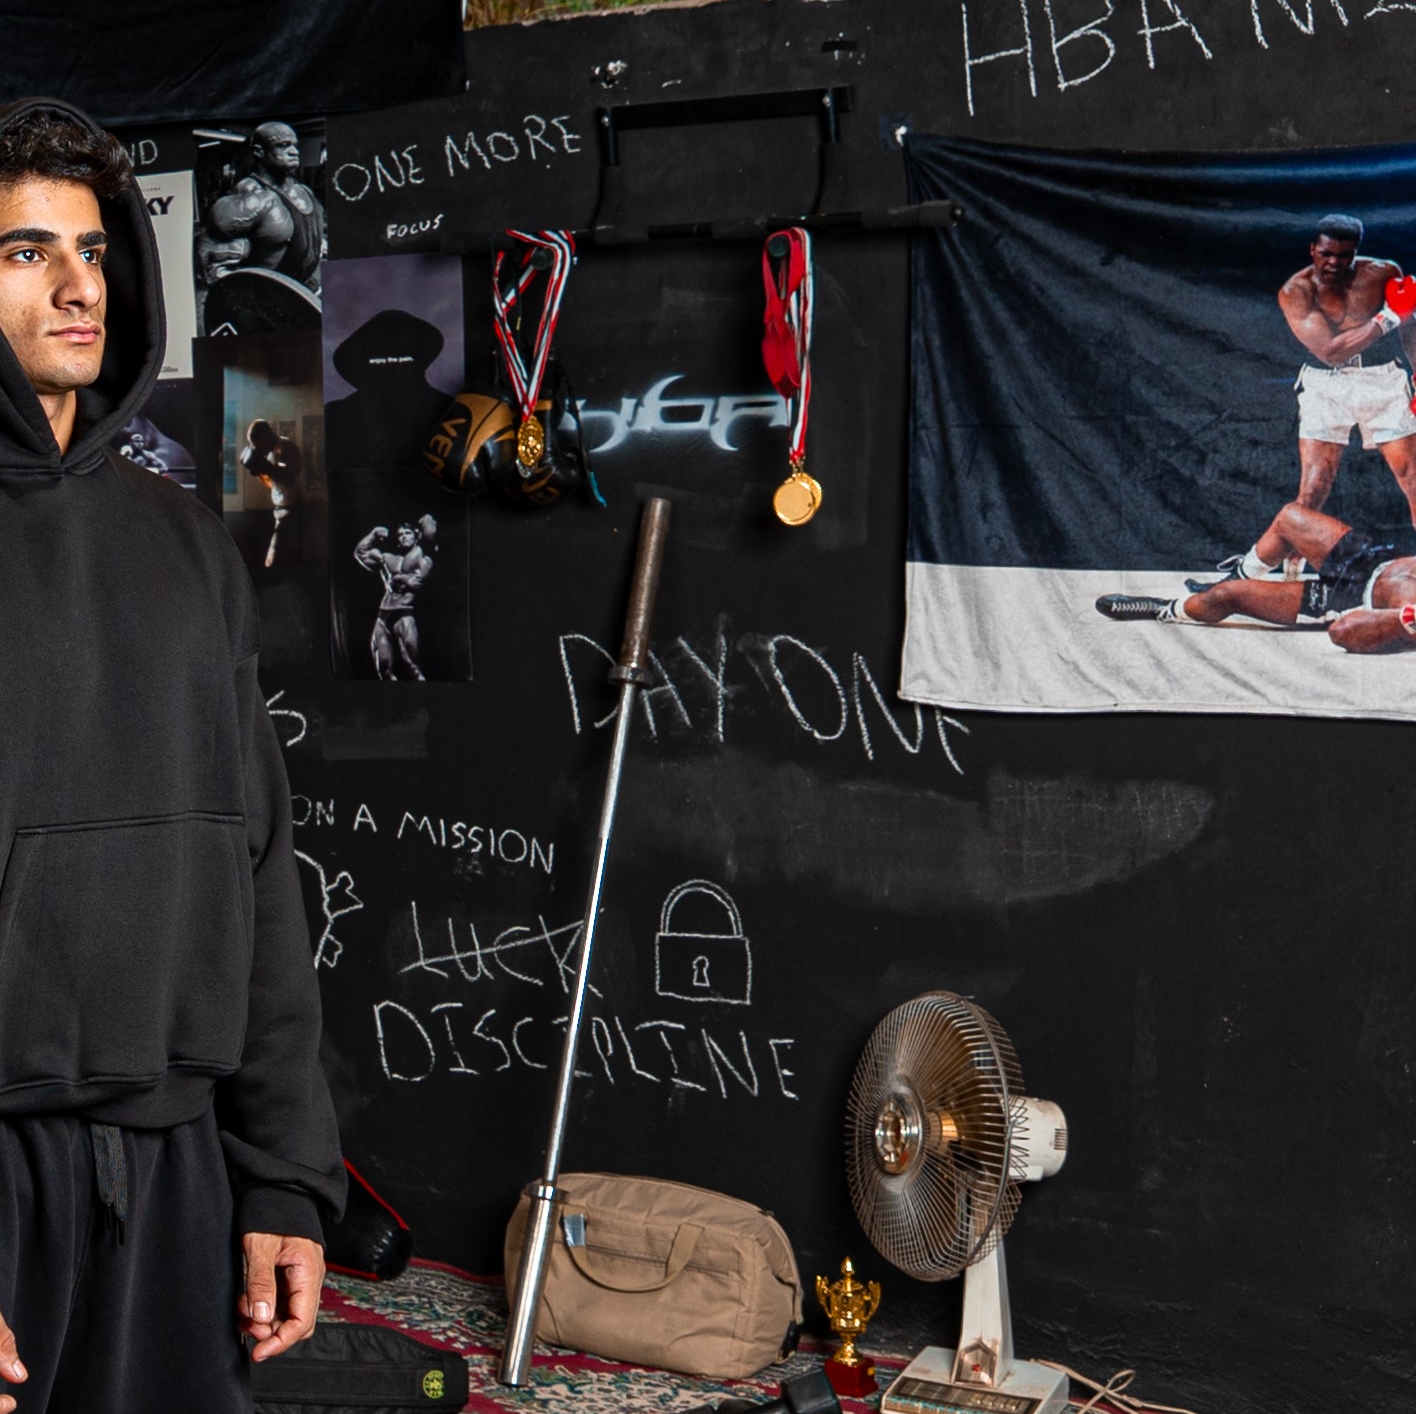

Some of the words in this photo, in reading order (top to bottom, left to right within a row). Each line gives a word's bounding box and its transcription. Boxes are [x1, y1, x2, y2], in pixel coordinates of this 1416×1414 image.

[333, 144, 425, 201] ONE
[444, 115, 582, 177] MORE
[386, 213, 444, 240] FOCUS
[352, 803, 377, 833] A
[397, 811, 554, 874] MISSION
